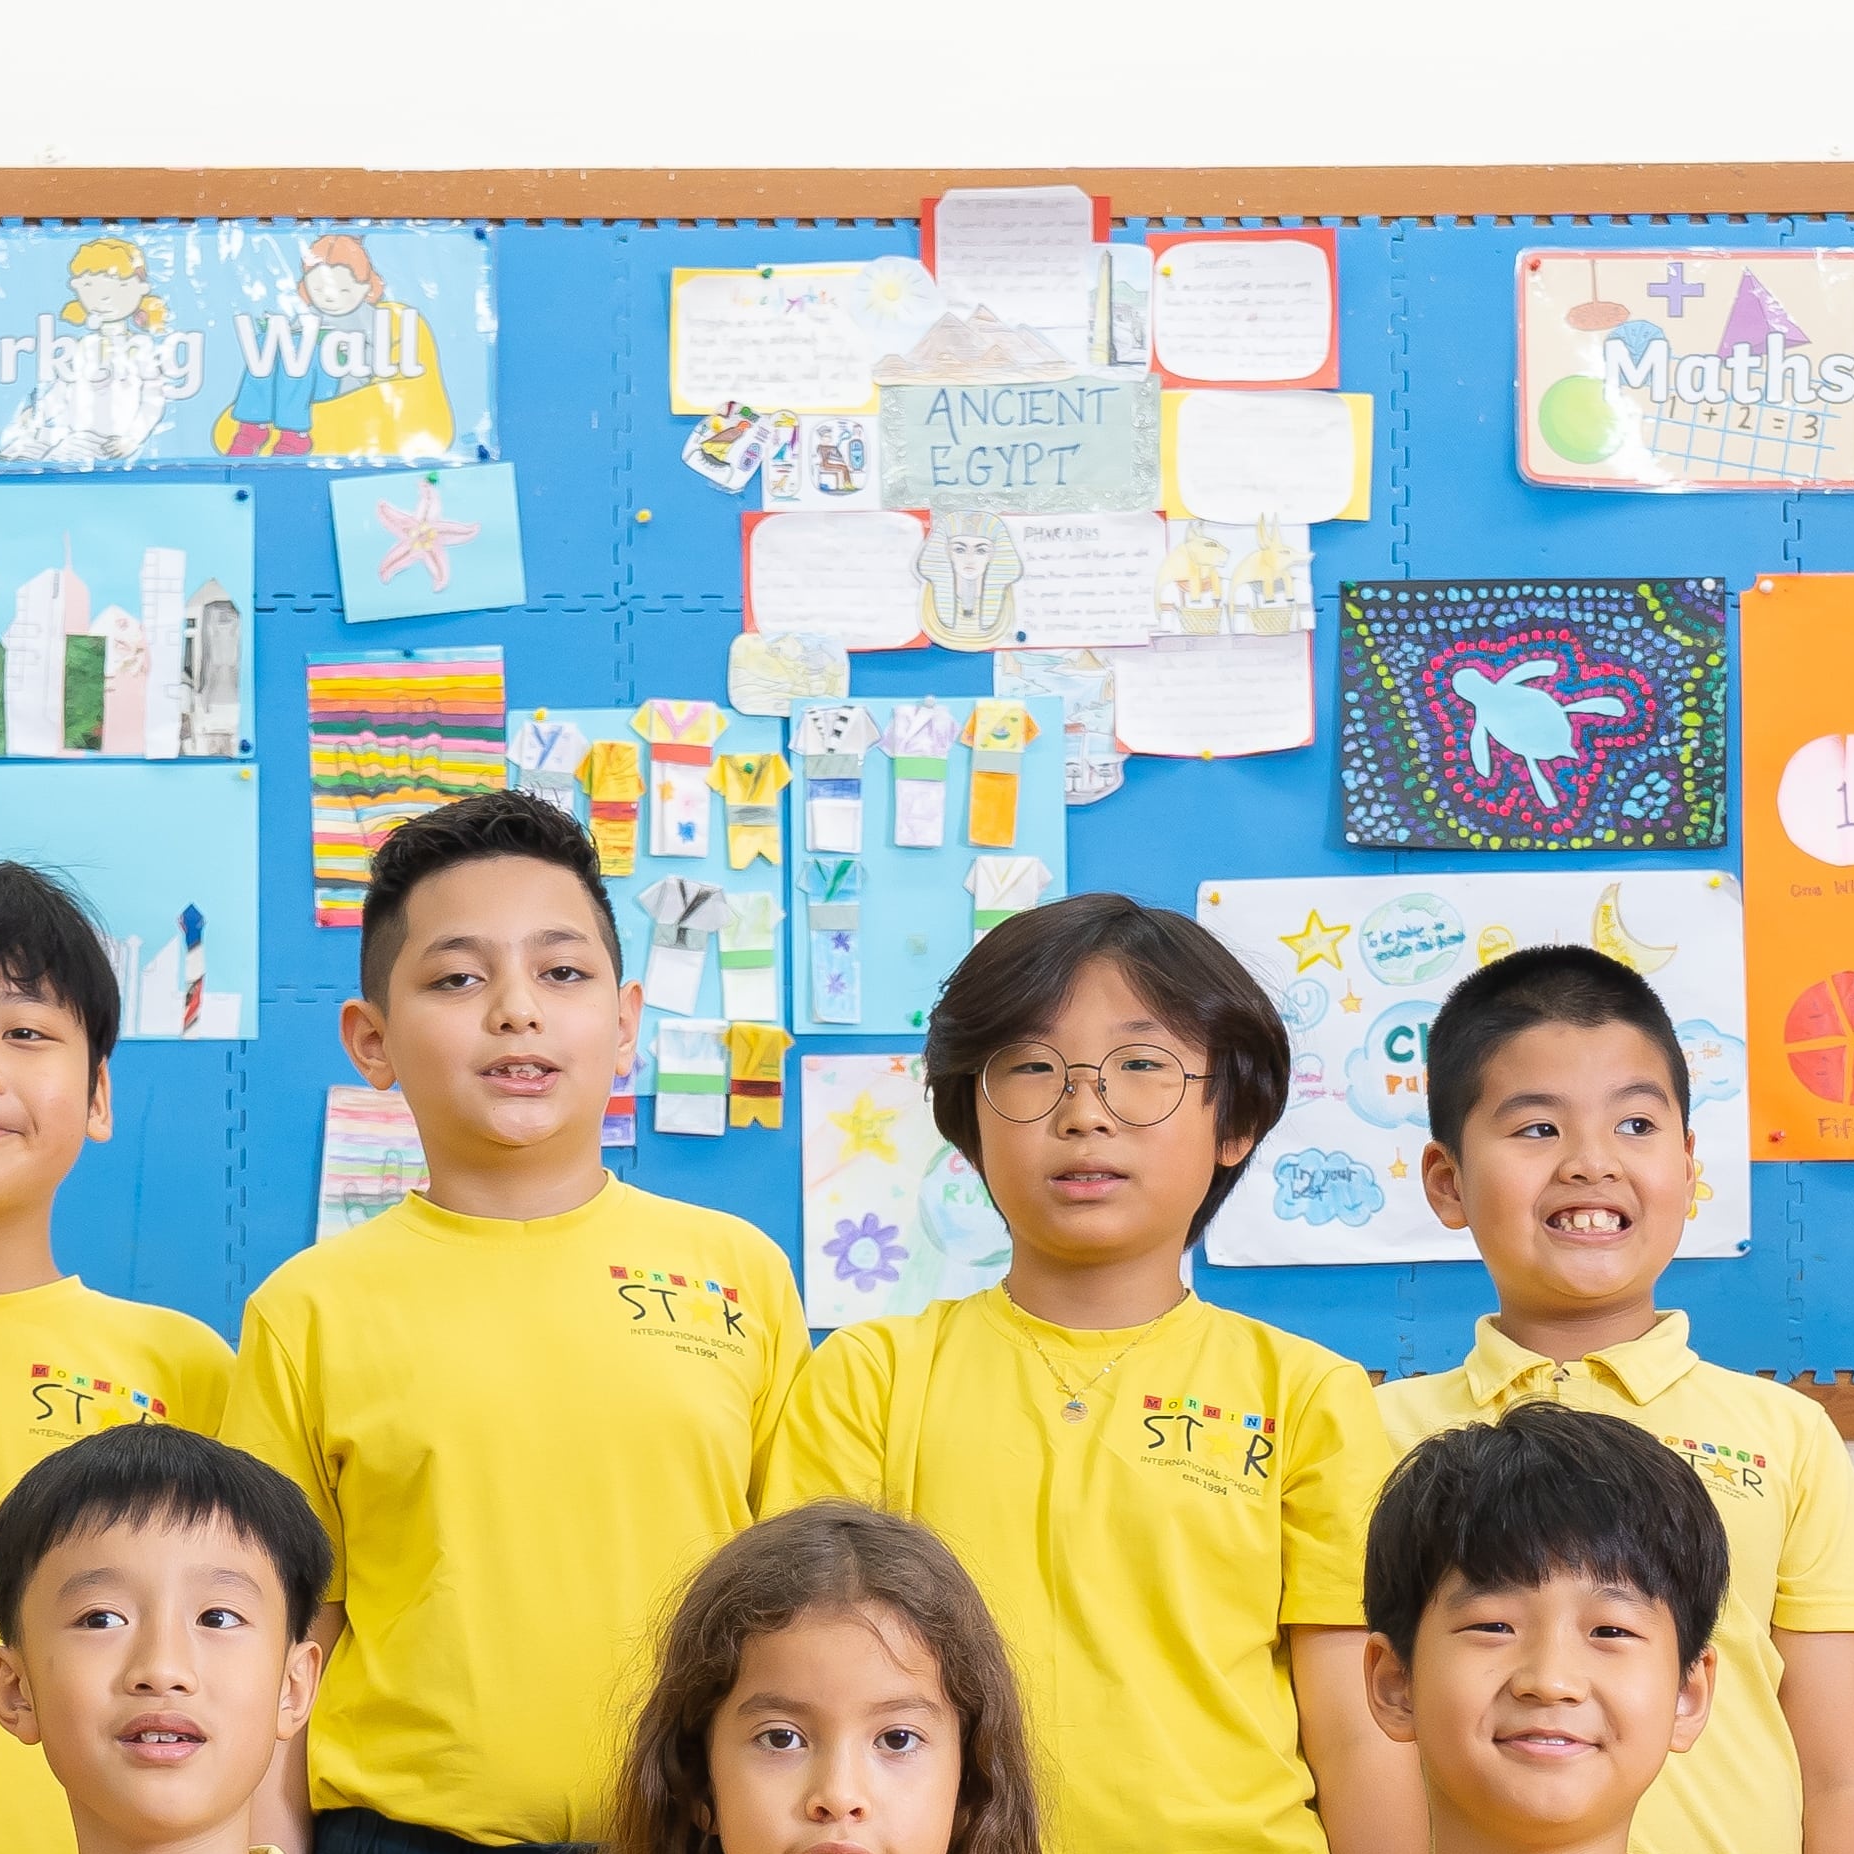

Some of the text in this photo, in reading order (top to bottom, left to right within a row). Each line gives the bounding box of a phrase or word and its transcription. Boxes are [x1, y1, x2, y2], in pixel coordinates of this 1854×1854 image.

[235, 308, 425, 378] Wall
[925, 387, 1120, 445] ANCIENT
[930, 442, 1082, 487] EGYPT
[1141, 1456, 1222, 1480] INTERNATIONAL
